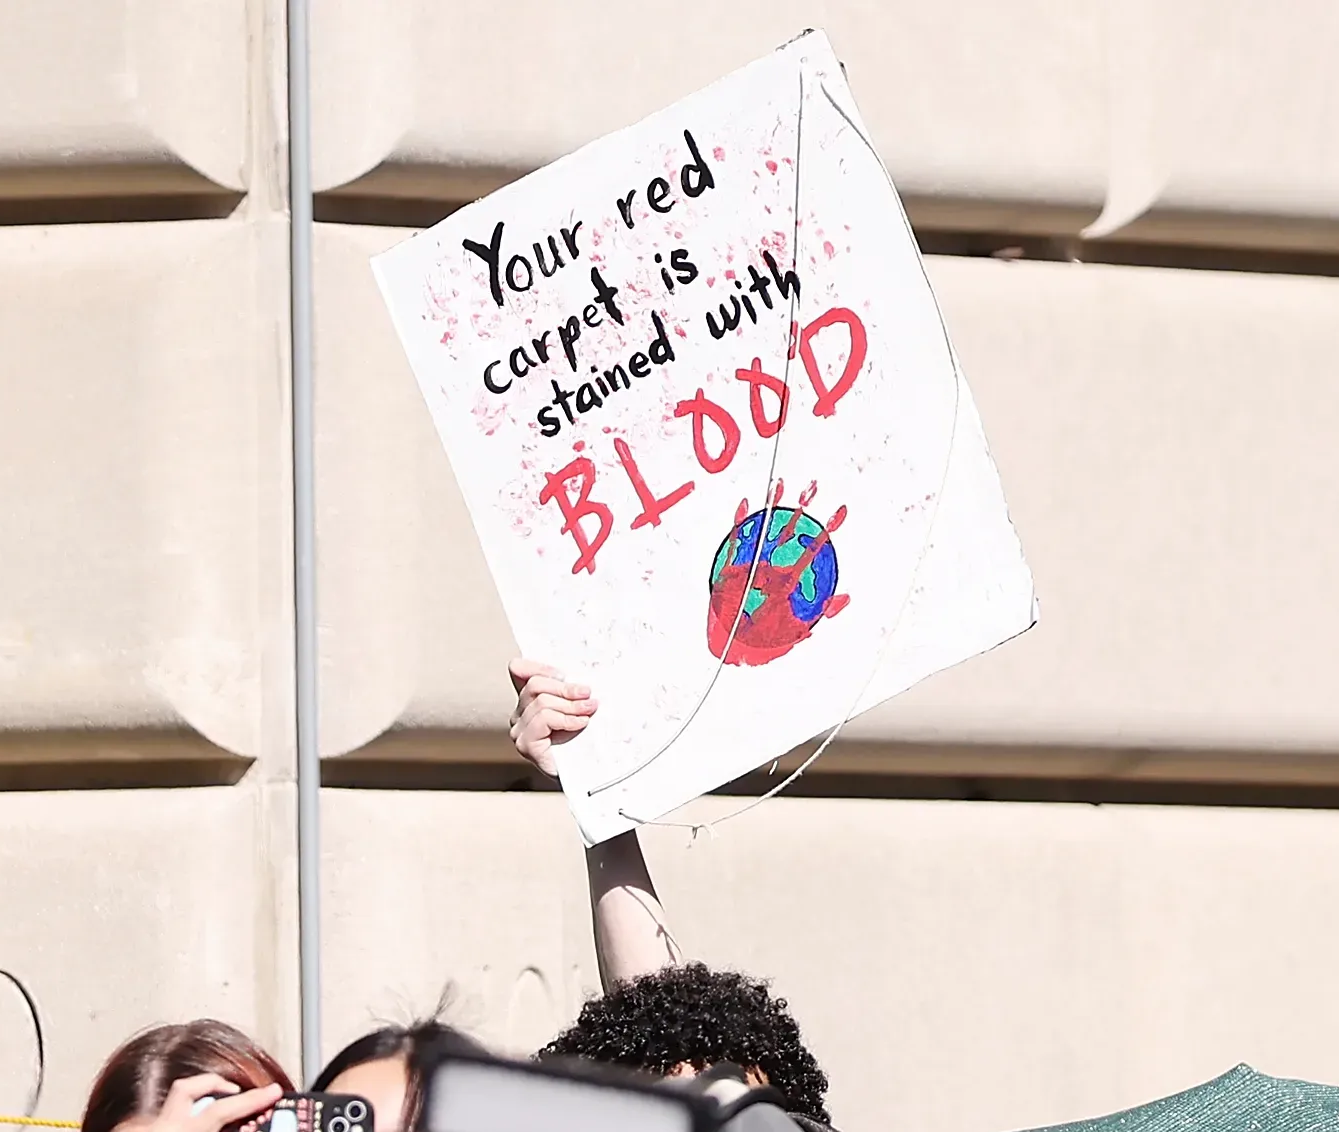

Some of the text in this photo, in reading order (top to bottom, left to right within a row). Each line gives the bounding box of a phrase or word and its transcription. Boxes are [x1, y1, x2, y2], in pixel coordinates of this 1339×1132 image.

[462, 129, 715, 308] Your red
[483, 248, 698, 394] carpet is
[536, 250, 801, 437] stained with
[538, 307, 868, 575] BLOOD
